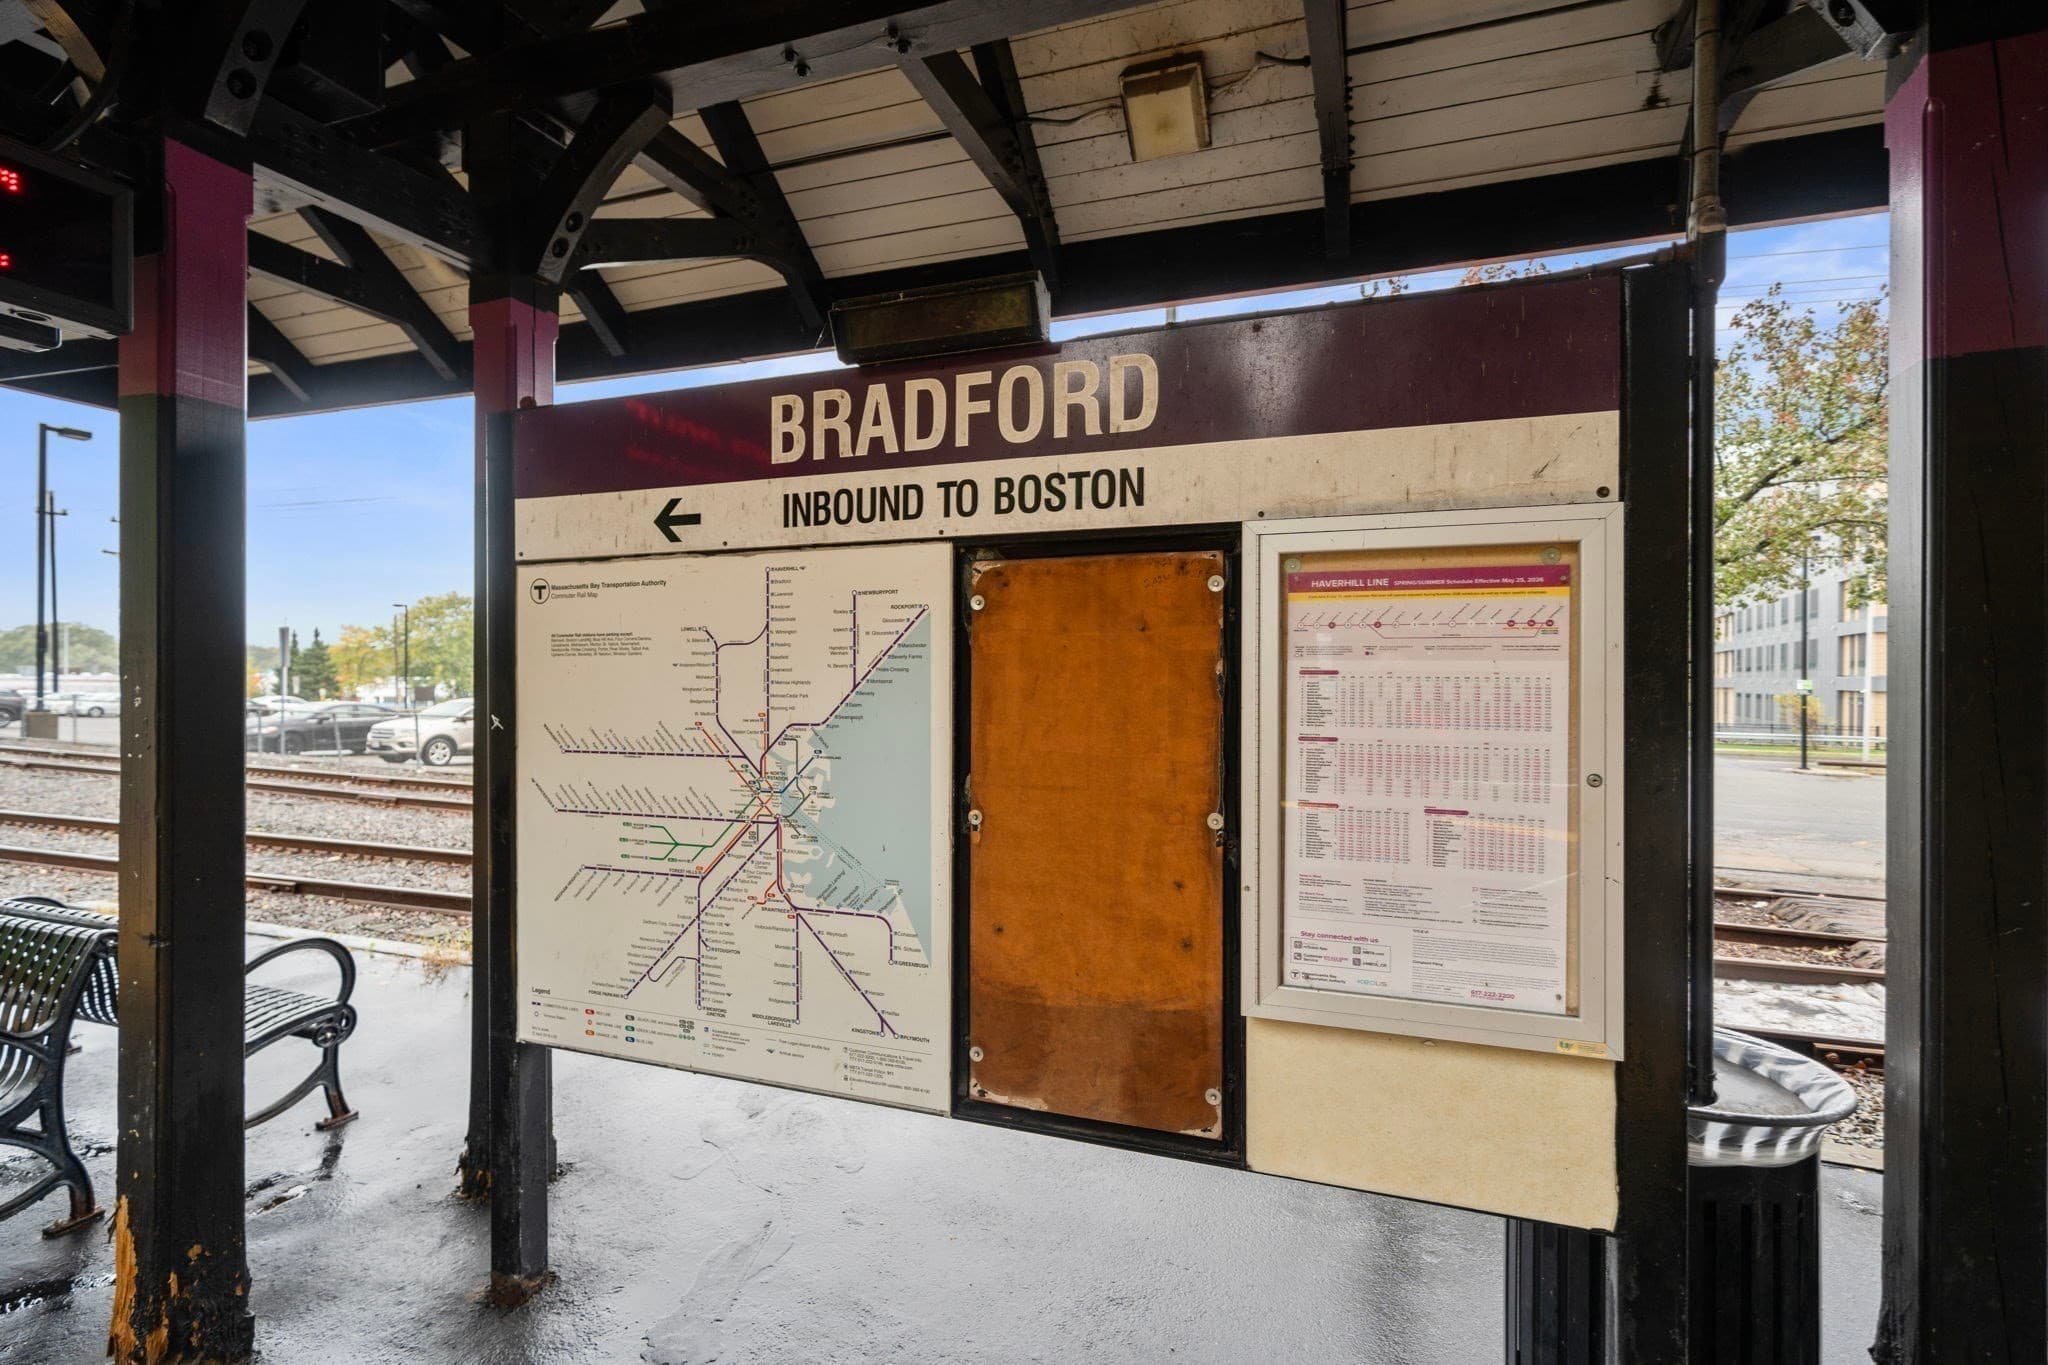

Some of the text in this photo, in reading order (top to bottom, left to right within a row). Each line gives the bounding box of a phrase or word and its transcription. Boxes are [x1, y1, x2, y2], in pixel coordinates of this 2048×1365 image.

[770, 353, 1160, 465] BRADFORD
[782, 467, 1145, 528] INBOUND TO BOSTON
[590, 582, 600, 590] Bay
[602, 580, 640, 590] Transportation
[641, 580, 666, 588] Authority
[1312, 579, 1364, 588] HAVERHILL
[1368, 578, 1389, 586] LINE
[534, 585, 546, 600] T
[1300, 930, 1316, 938] Stay
[1316, 932, 1352, 940] connected
[898, 960, 929, 968] GREENBUSH
[532, 986, 550, 995] Legend
[904, 1034, 930, 1043] PLYMOUTH
